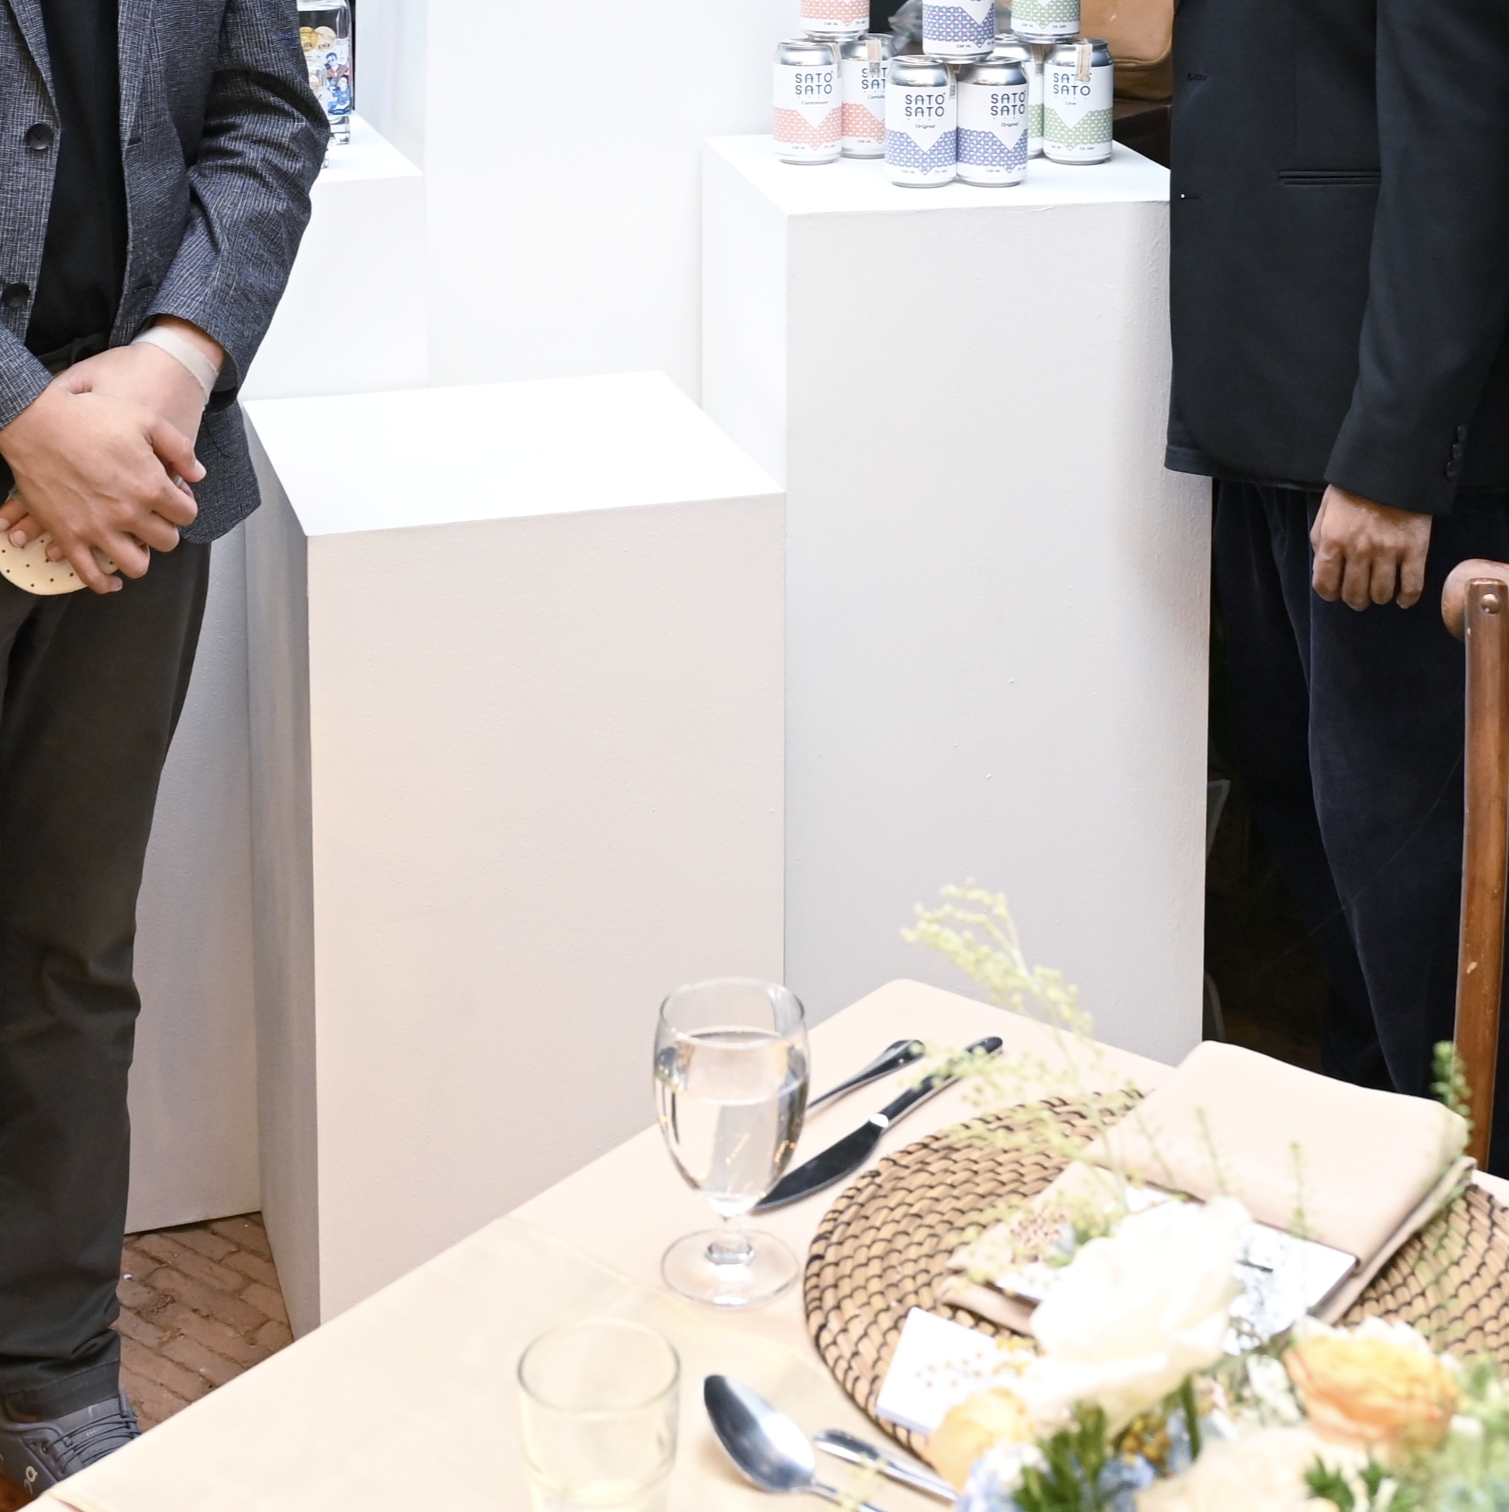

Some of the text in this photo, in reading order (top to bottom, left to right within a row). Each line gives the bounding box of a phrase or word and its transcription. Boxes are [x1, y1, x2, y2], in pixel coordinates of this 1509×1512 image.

[795, 72, 833, 84] SATO
[795, 84, 833, 95] SATO
[861, 79, 885, 90] SAT
[1053, 84, 1091, 96] SATO
[905, 94, 945, 105] SATO
[991, 92, 1026, 104] SATO
[905, 106, 945, 117] SATO
[991, 104, 1026, 116] SATO
